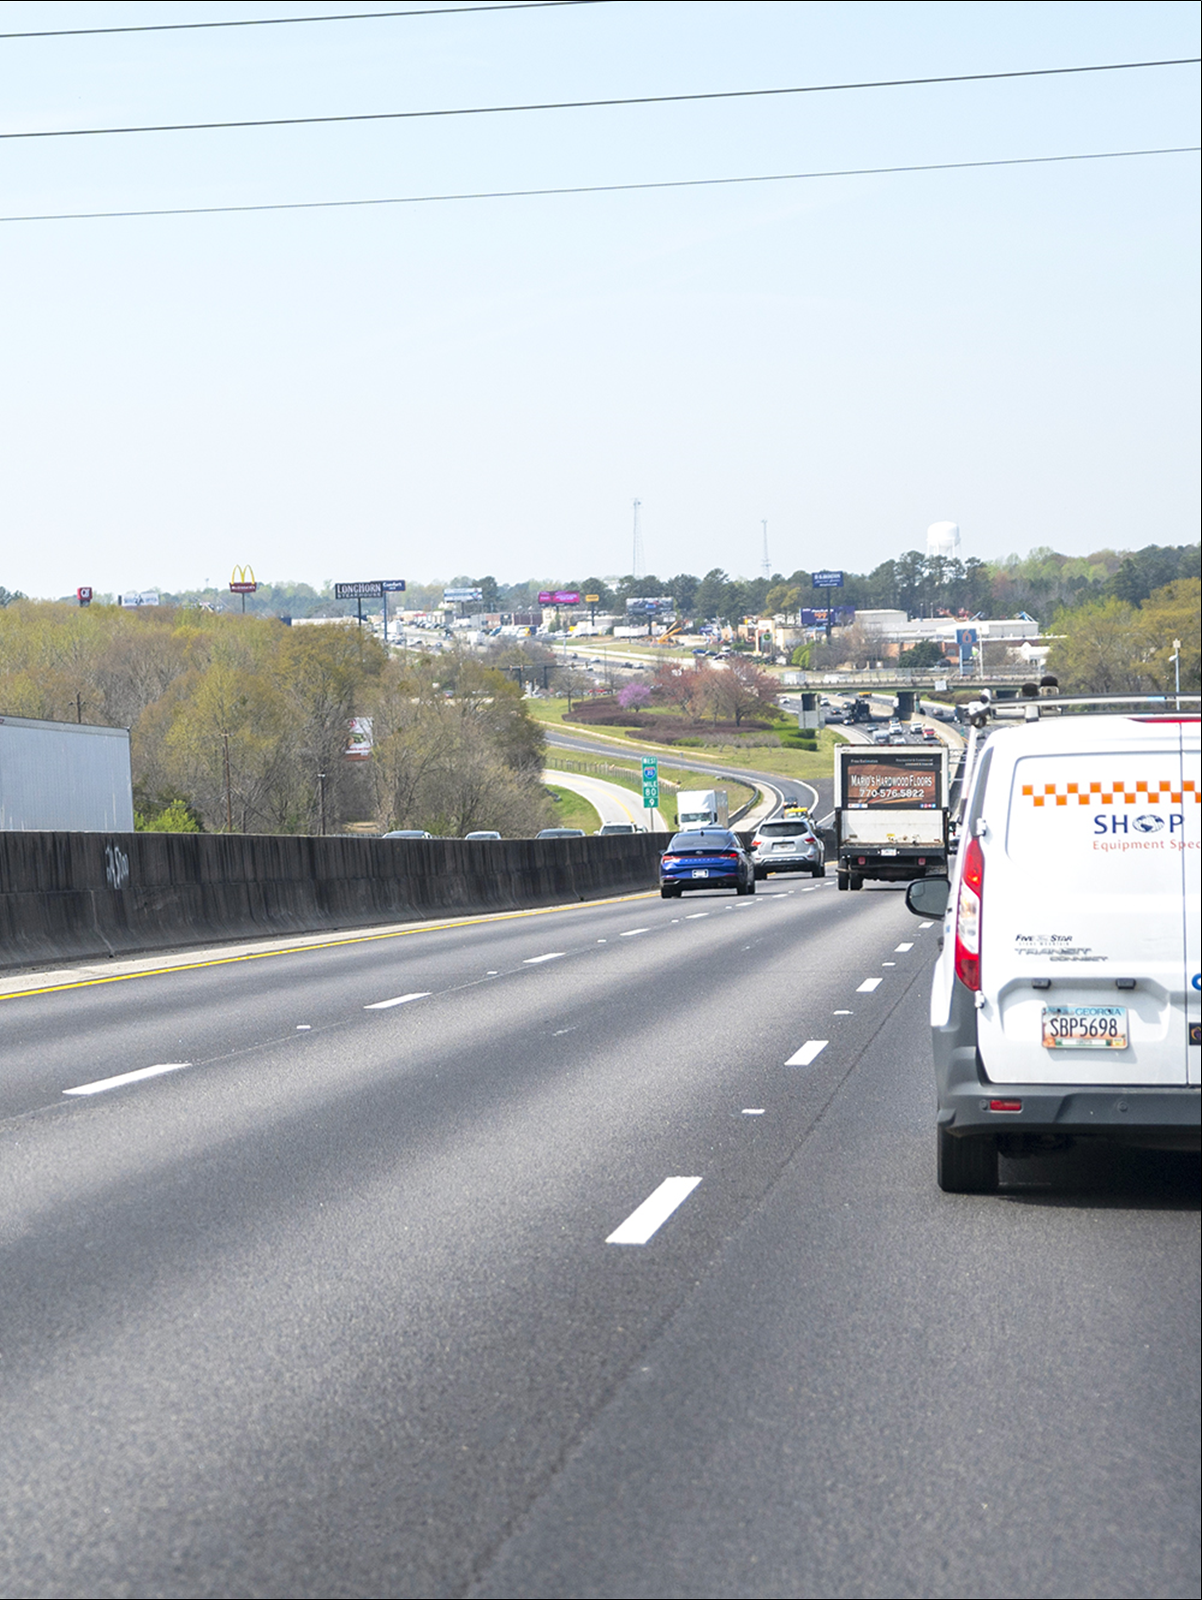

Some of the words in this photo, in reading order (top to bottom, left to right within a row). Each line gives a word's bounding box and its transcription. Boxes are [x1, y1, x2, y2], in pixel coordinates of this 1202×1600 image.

[337, 582, 382, 594] LONGHORN
[962, 630, 973, 644] 6
[851, 774, 876, 787] MARIO'S
[876, 774, 909, 787] HARDWOOD
[909, 774, 933, 787] FLOORS
[645, 787, 657, 797] 80
[1093, 839, 1164, 852] Equipment
[1050, 934, 1073, 942] STAR
[1075, 1007, 1122, 1016] GEORGIA
[1050, 1017, 1118, 1038] SBP5698
